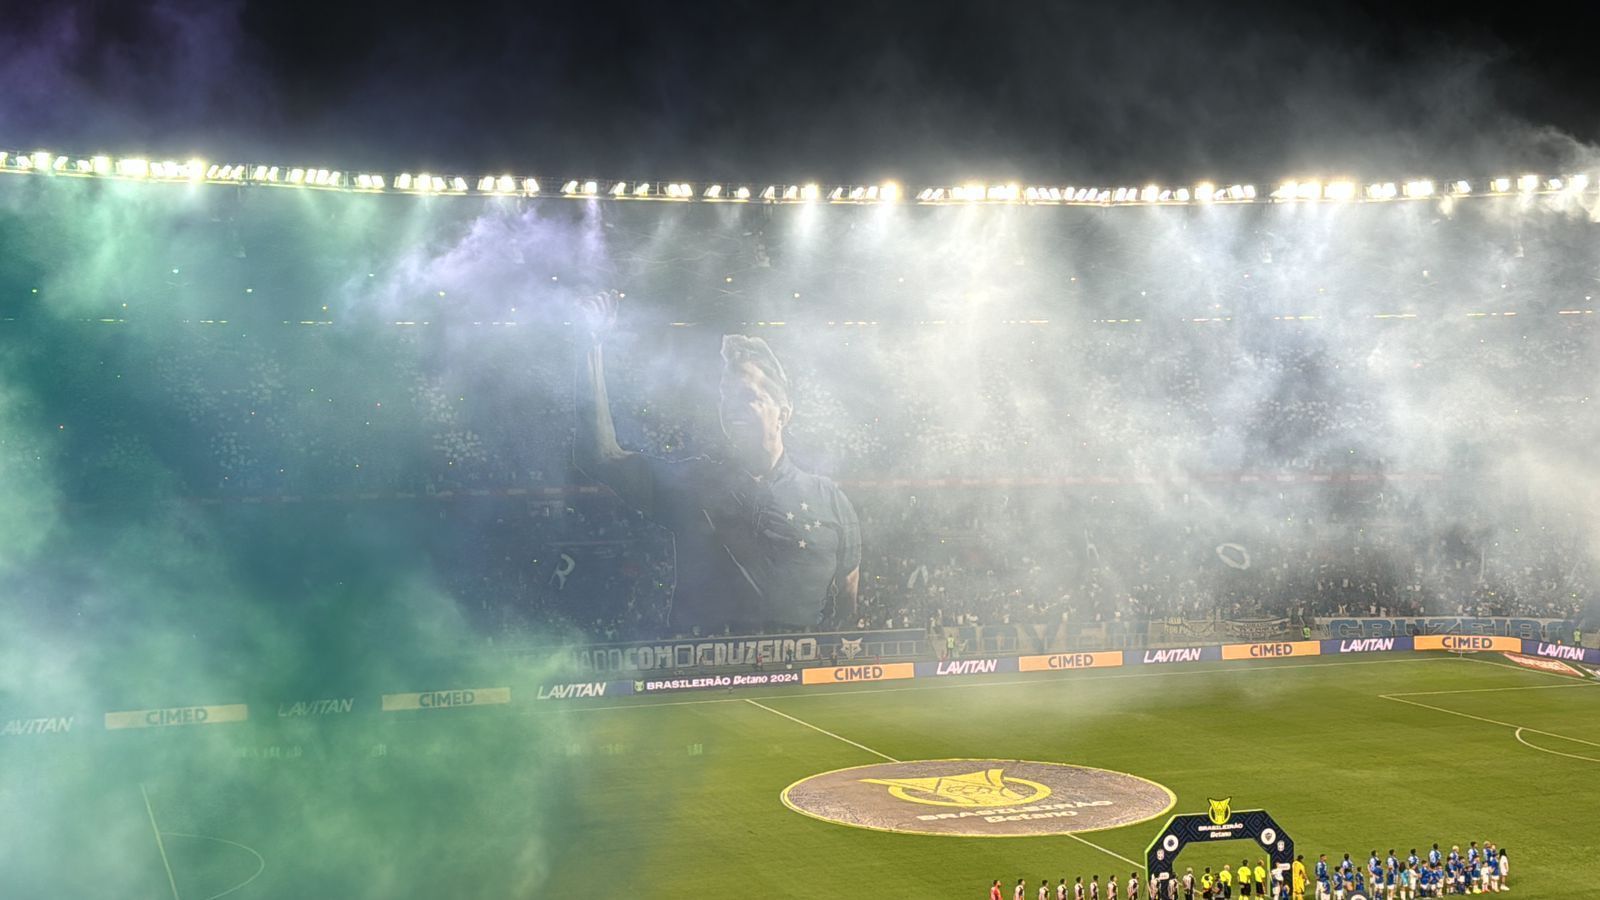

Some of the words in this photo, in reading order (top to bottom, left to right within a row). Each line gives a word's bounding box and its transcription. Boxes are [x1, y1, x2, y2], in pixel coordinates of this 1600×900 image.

[1250, 643, 1293, 657] CIMED
[1340, 637, 1394, 653] LAVITAN
[1441, 636, 1493, 649] CIMED
[625, 645, 672, 671] COM
[697, 637, 817, 667] CRUZEIRO
[1143, 647, 1201, 664] LAVITAN
[1537, 642, 1585, 661] LAVITAN
[936, 658, 998, 675] LAVITAN
[1048, 653, 1094, 668] CIMED
[646, 675, 731, 690] BRASILEIRÃO
[733, 674, 768, 685] Betano
[770, 673, 799, 683] 2024
[834, 665, 883, 681] CIMED
[418, 690, 475, 708] CIMED
[537, 682, 606, 700] LAVITAN
[278, 697, 354, 718] LAVITAN
[146, 707, 208, 726] CIMED
[0, 716, 74, 736] AVITAN
[984, 810, 1078, 824] Betano
